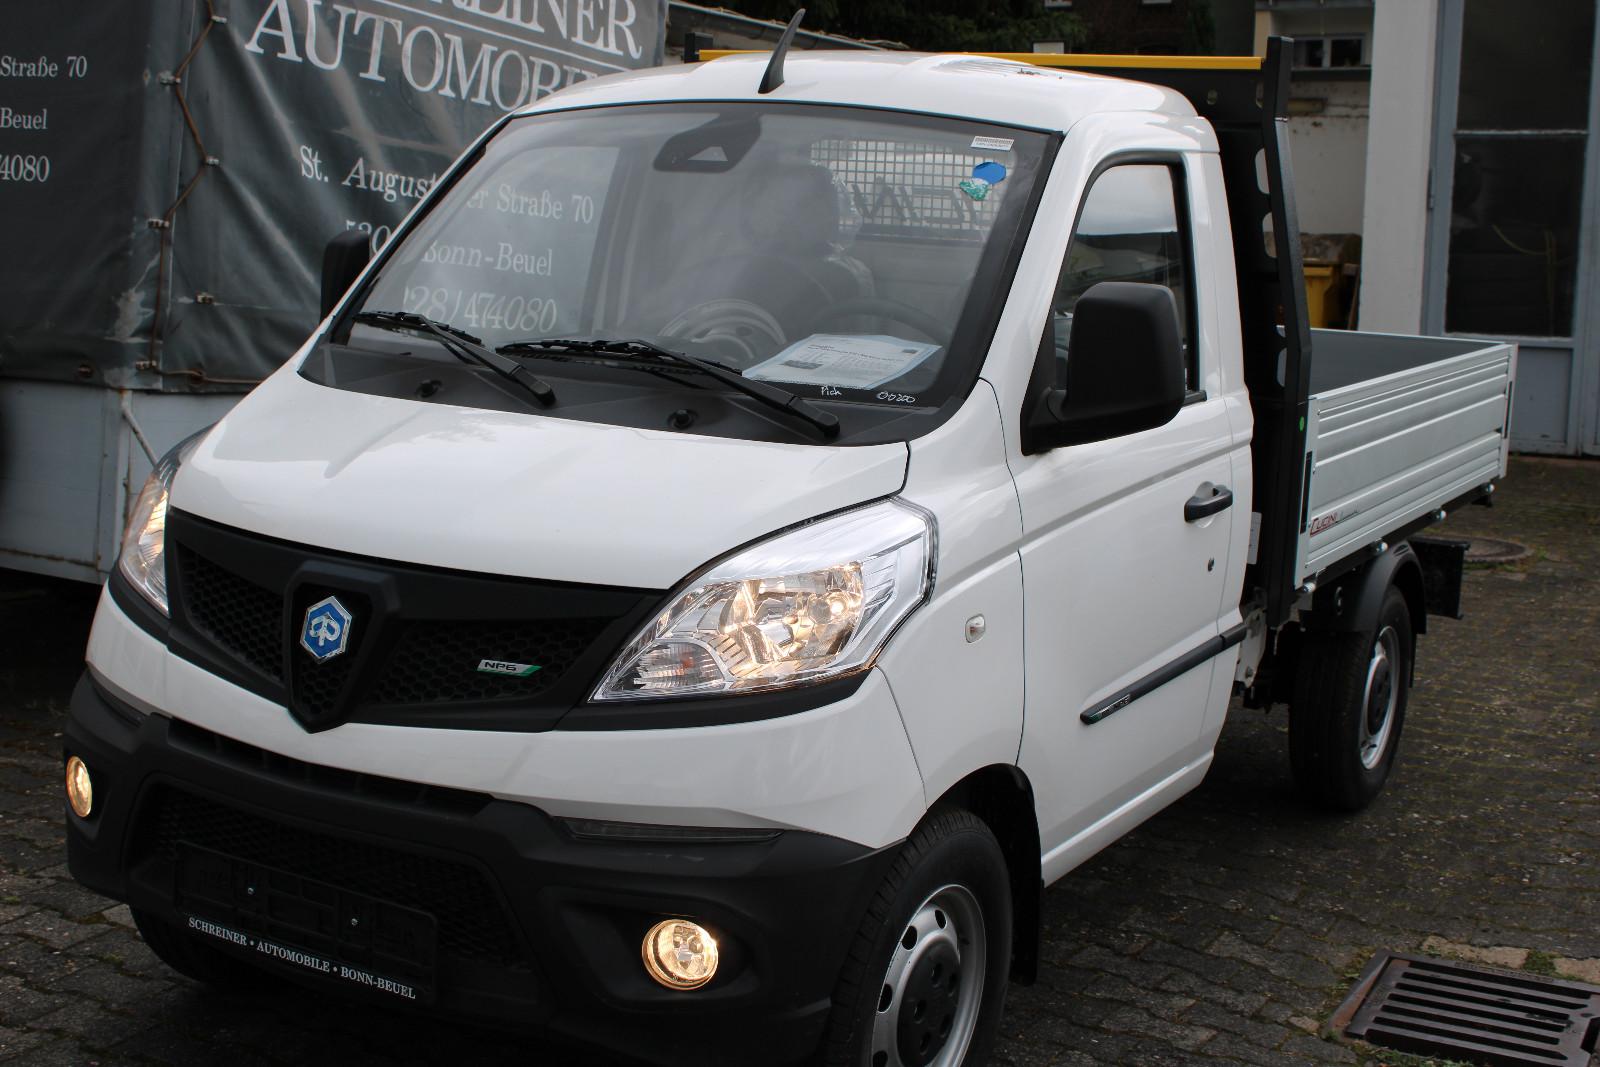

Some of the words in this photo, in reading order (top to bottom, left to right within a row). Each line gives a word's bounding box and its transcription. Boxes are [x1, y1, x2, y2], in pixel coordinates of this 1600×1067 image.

[66, 56, 87, 78] 70
[244, 0, 598, 111] AUTOMOB
[0, 107, 48, 130] Beuel
[0, 154, 50, 183] 4080
[300, 145, 329, 182] St.
[497, 183, 562, 220] Straße
[571, 195, 594, 224] 70
[484, 661, 517, 671] NP6
[188, 916, 247, 946] SCHREINER
[256, 940, 330, 973] AUTOMOBILE
[340, 966, 416, 1000] BONN-BEUEL
